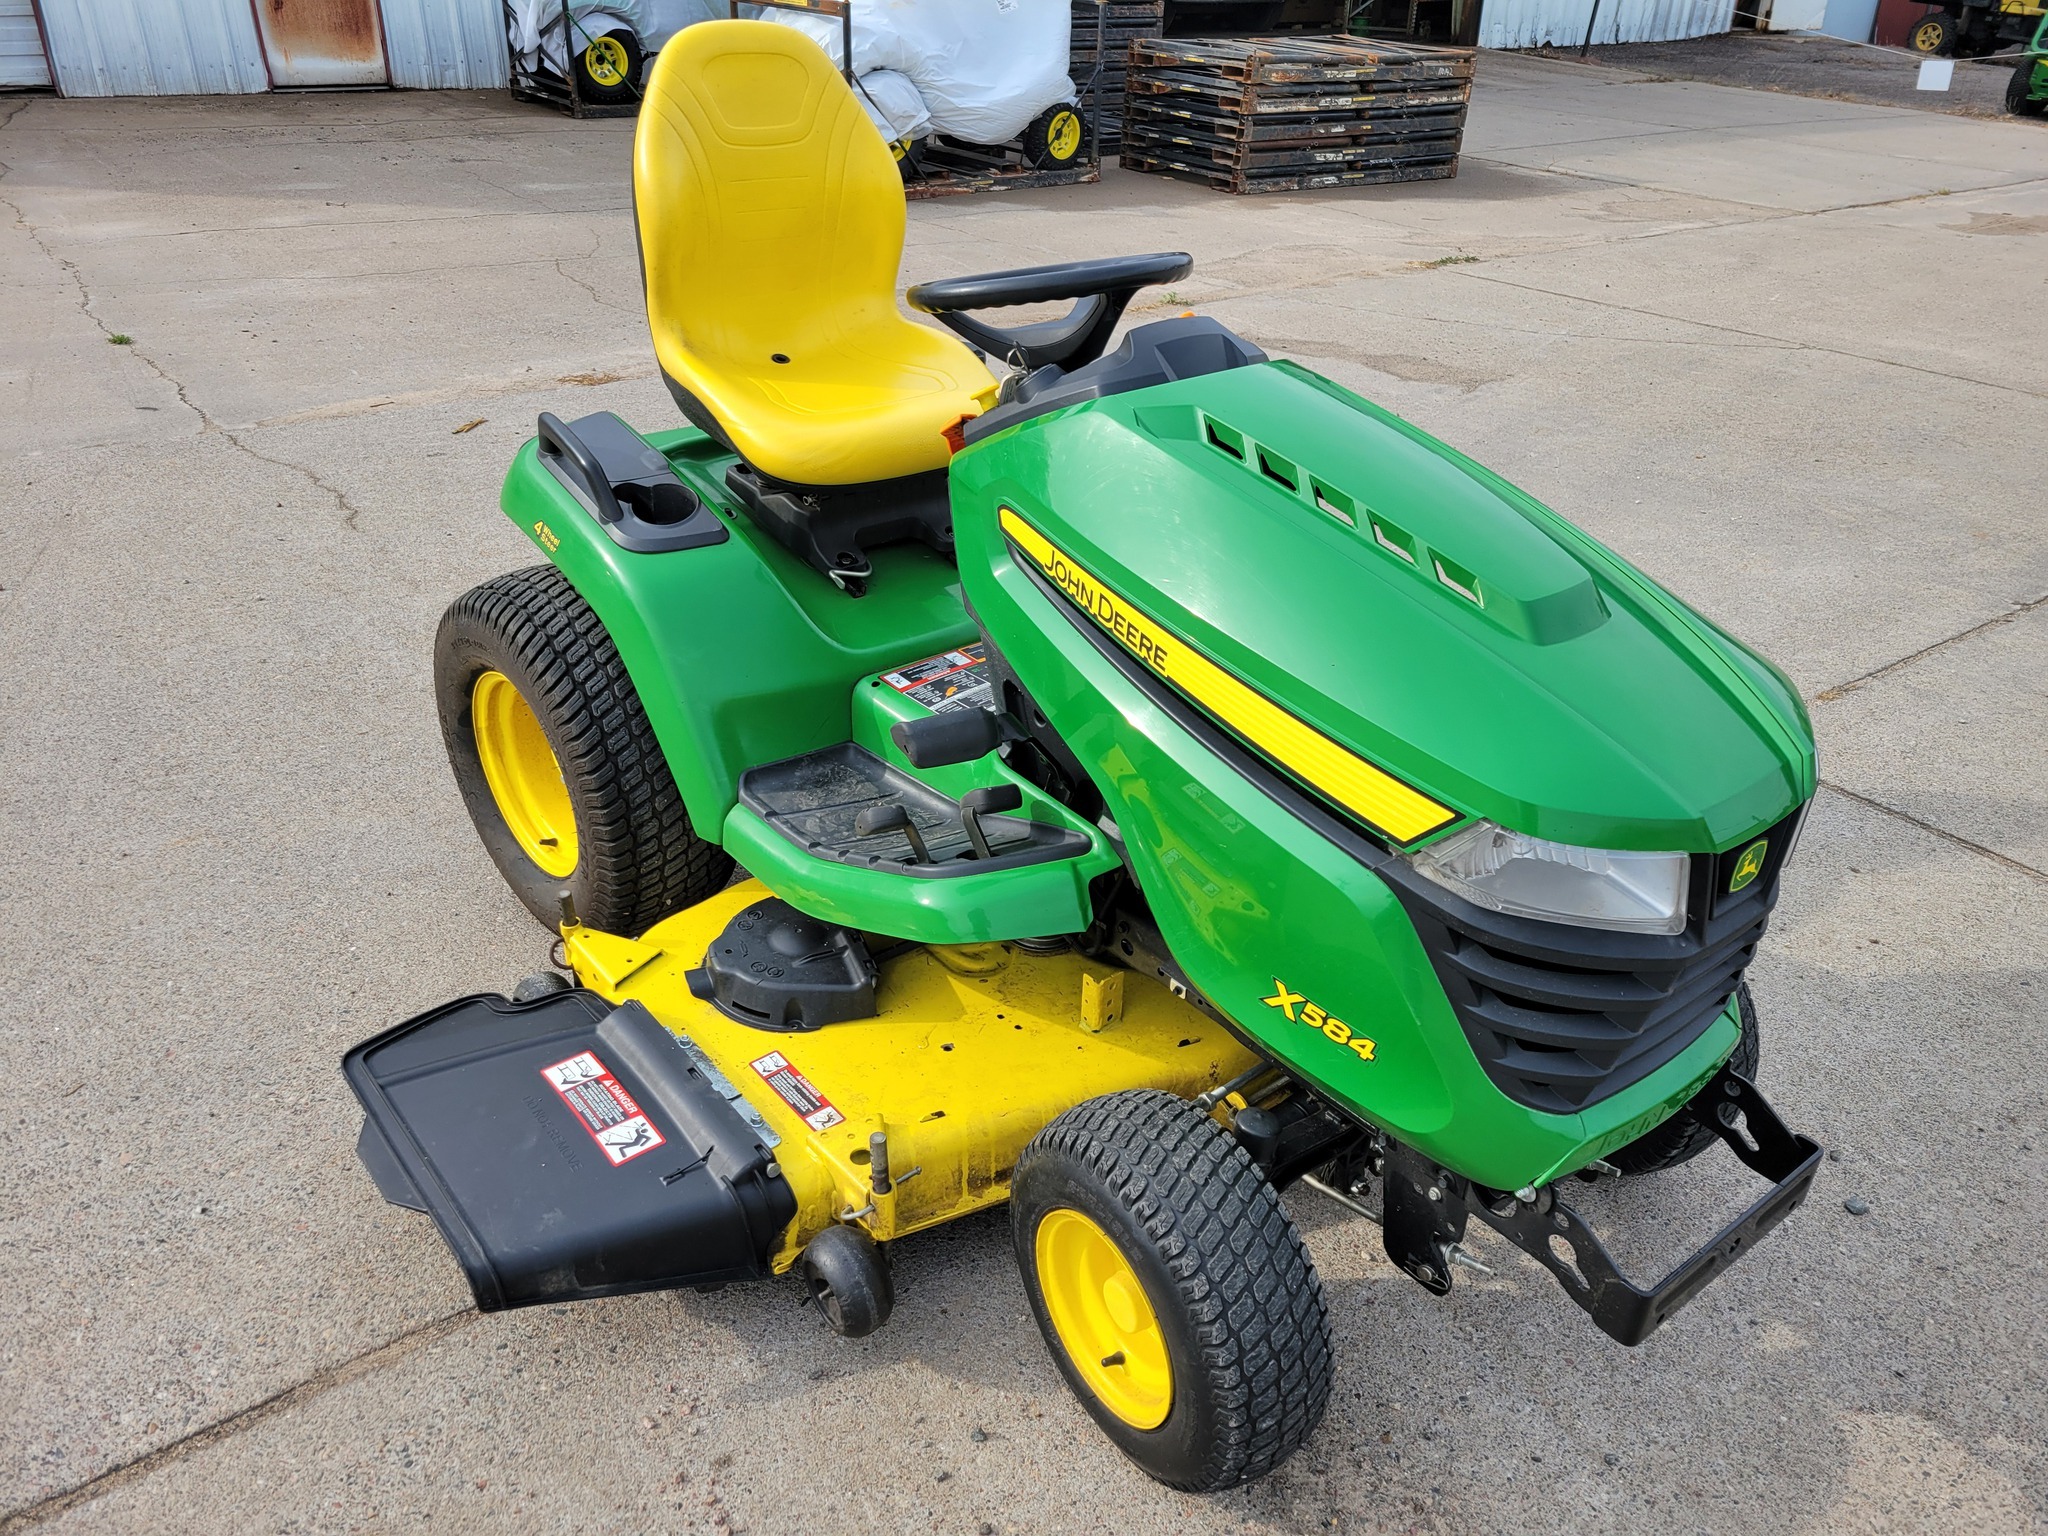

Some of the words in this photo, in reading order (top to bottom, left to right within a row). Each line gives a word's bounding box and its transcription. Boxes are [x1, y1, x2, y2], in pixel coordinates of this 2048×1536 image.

[533, 521, 544, 536] 4
[543, 524, 561, 547] Wheel
[540, 533, 557, 552] Steer
[1044, 550, 1094, 610] JOHN
[1098, 592, 1168, 672] DEERE
[1260, 977, 1377, 1062] X584
[609, 1084, 639, 1114] DANGER
[800, 1078, 822, 1098] DANGER
